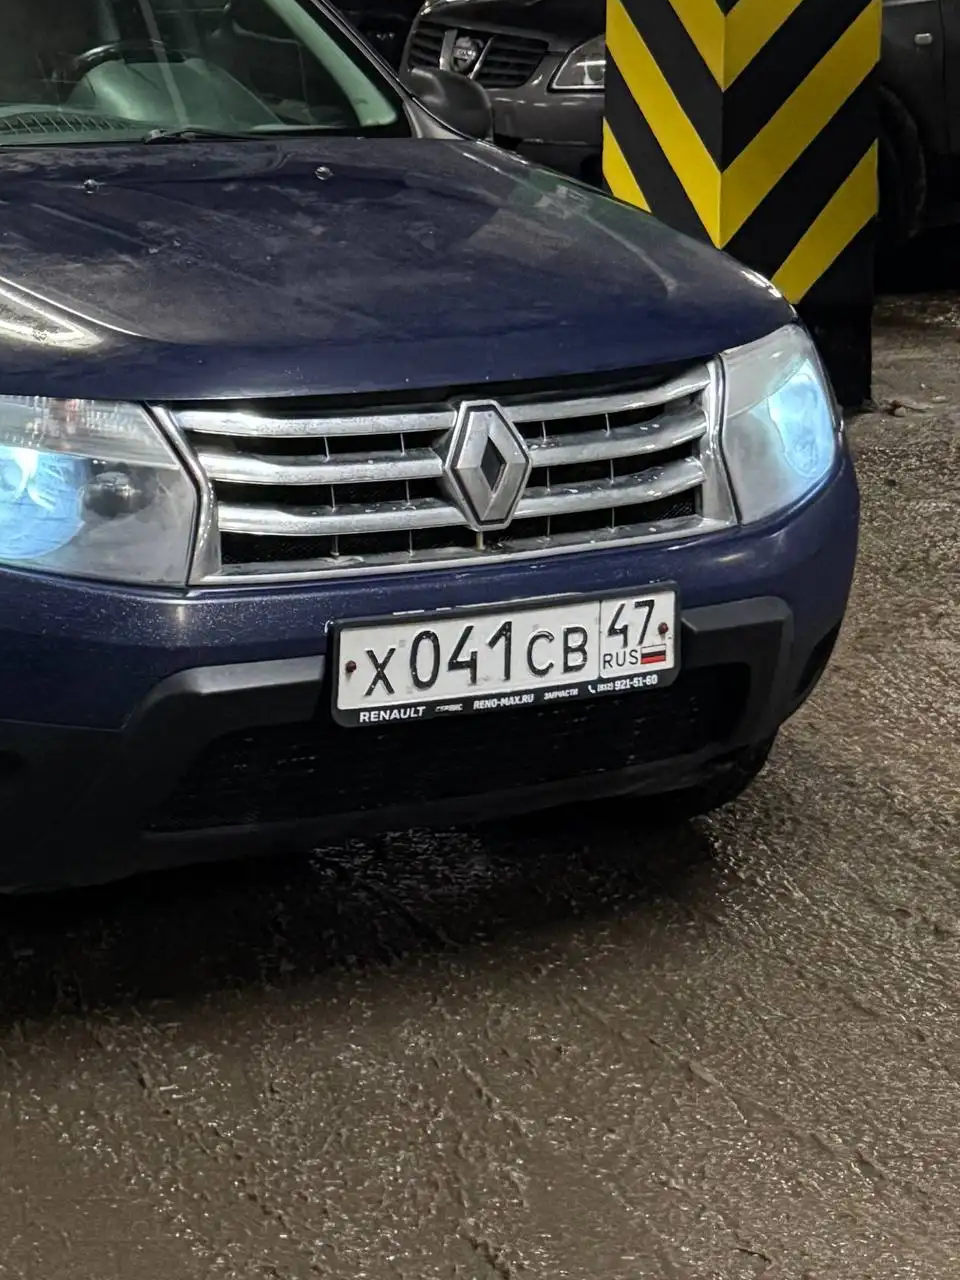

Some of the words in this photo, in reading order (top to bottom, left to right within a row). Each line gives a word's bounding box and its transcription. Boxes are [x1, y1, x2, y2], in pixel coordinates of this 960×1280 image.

[607, 599, 655, 649] 47
[602, 649, 639, 670] RUS
[473, 694, 535, 710] RENO-MAX.RU
[359, 706, 426, 723] RENAULT
